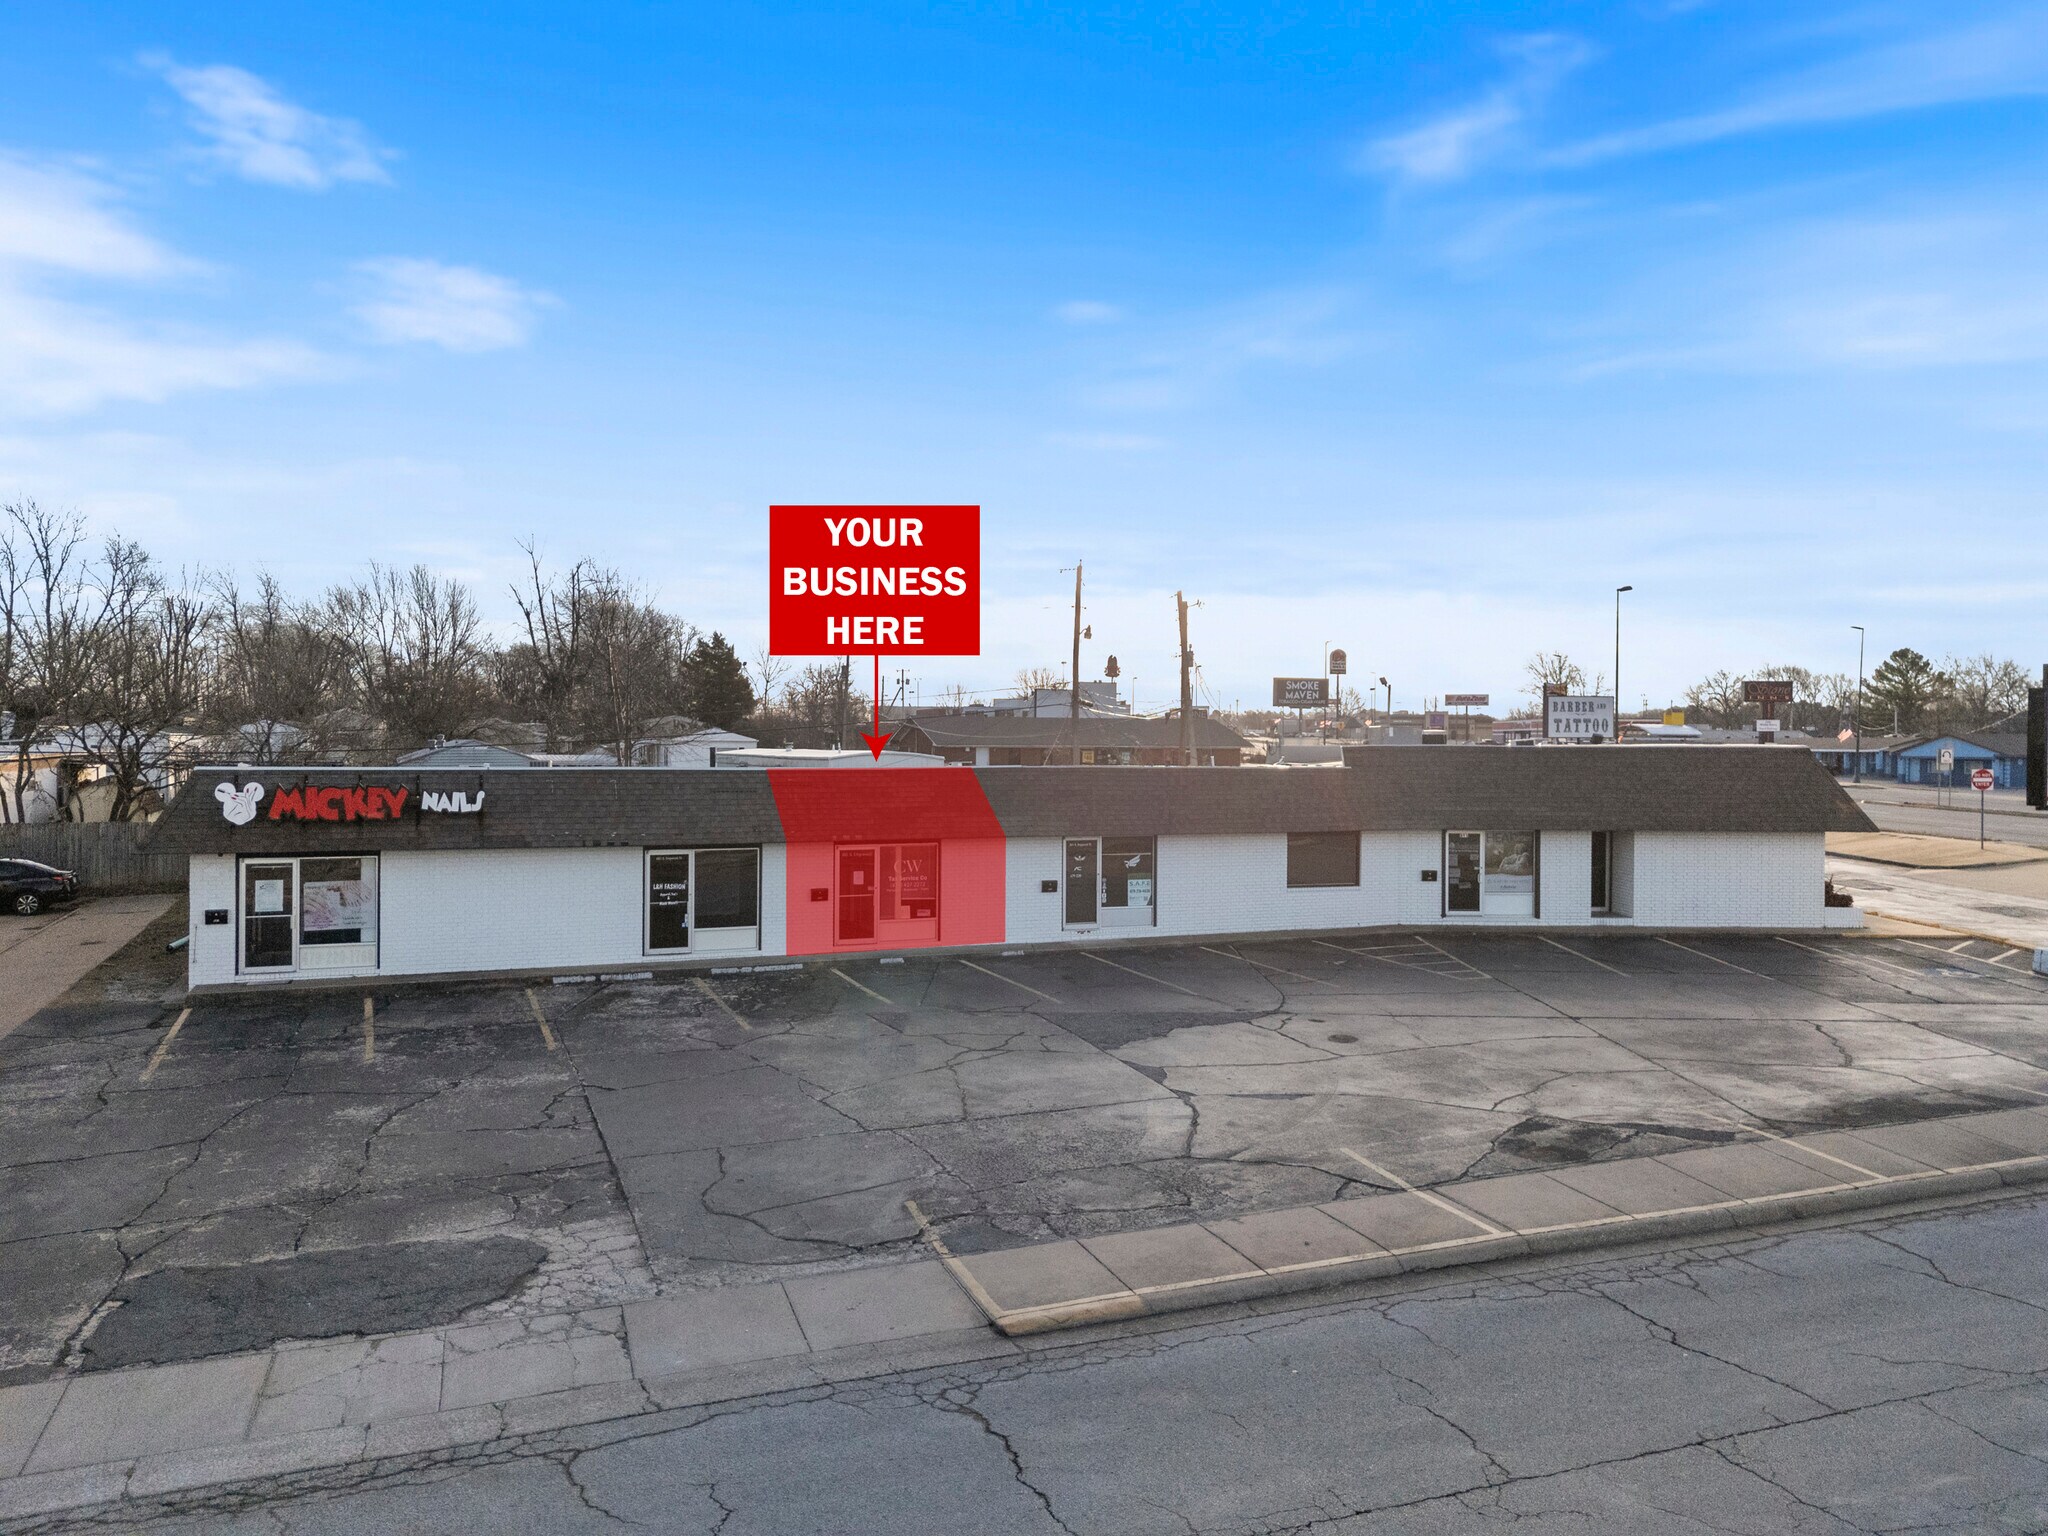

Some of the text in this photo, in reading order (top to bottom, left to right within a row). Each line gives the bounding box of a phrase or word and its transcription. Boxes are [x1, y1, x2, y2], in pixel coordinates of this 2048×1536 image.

[1286, 681, 1319, 690] SMOKE
[1285, 691, 1319, 699] MAVEN
[1552, 701, 1595, 712] BARBER
[1553, 718, 1609, 733] TATTOO
[268, 785, 485, 821] MICKEY NAILS
[893, 859, 923, 873] CW
